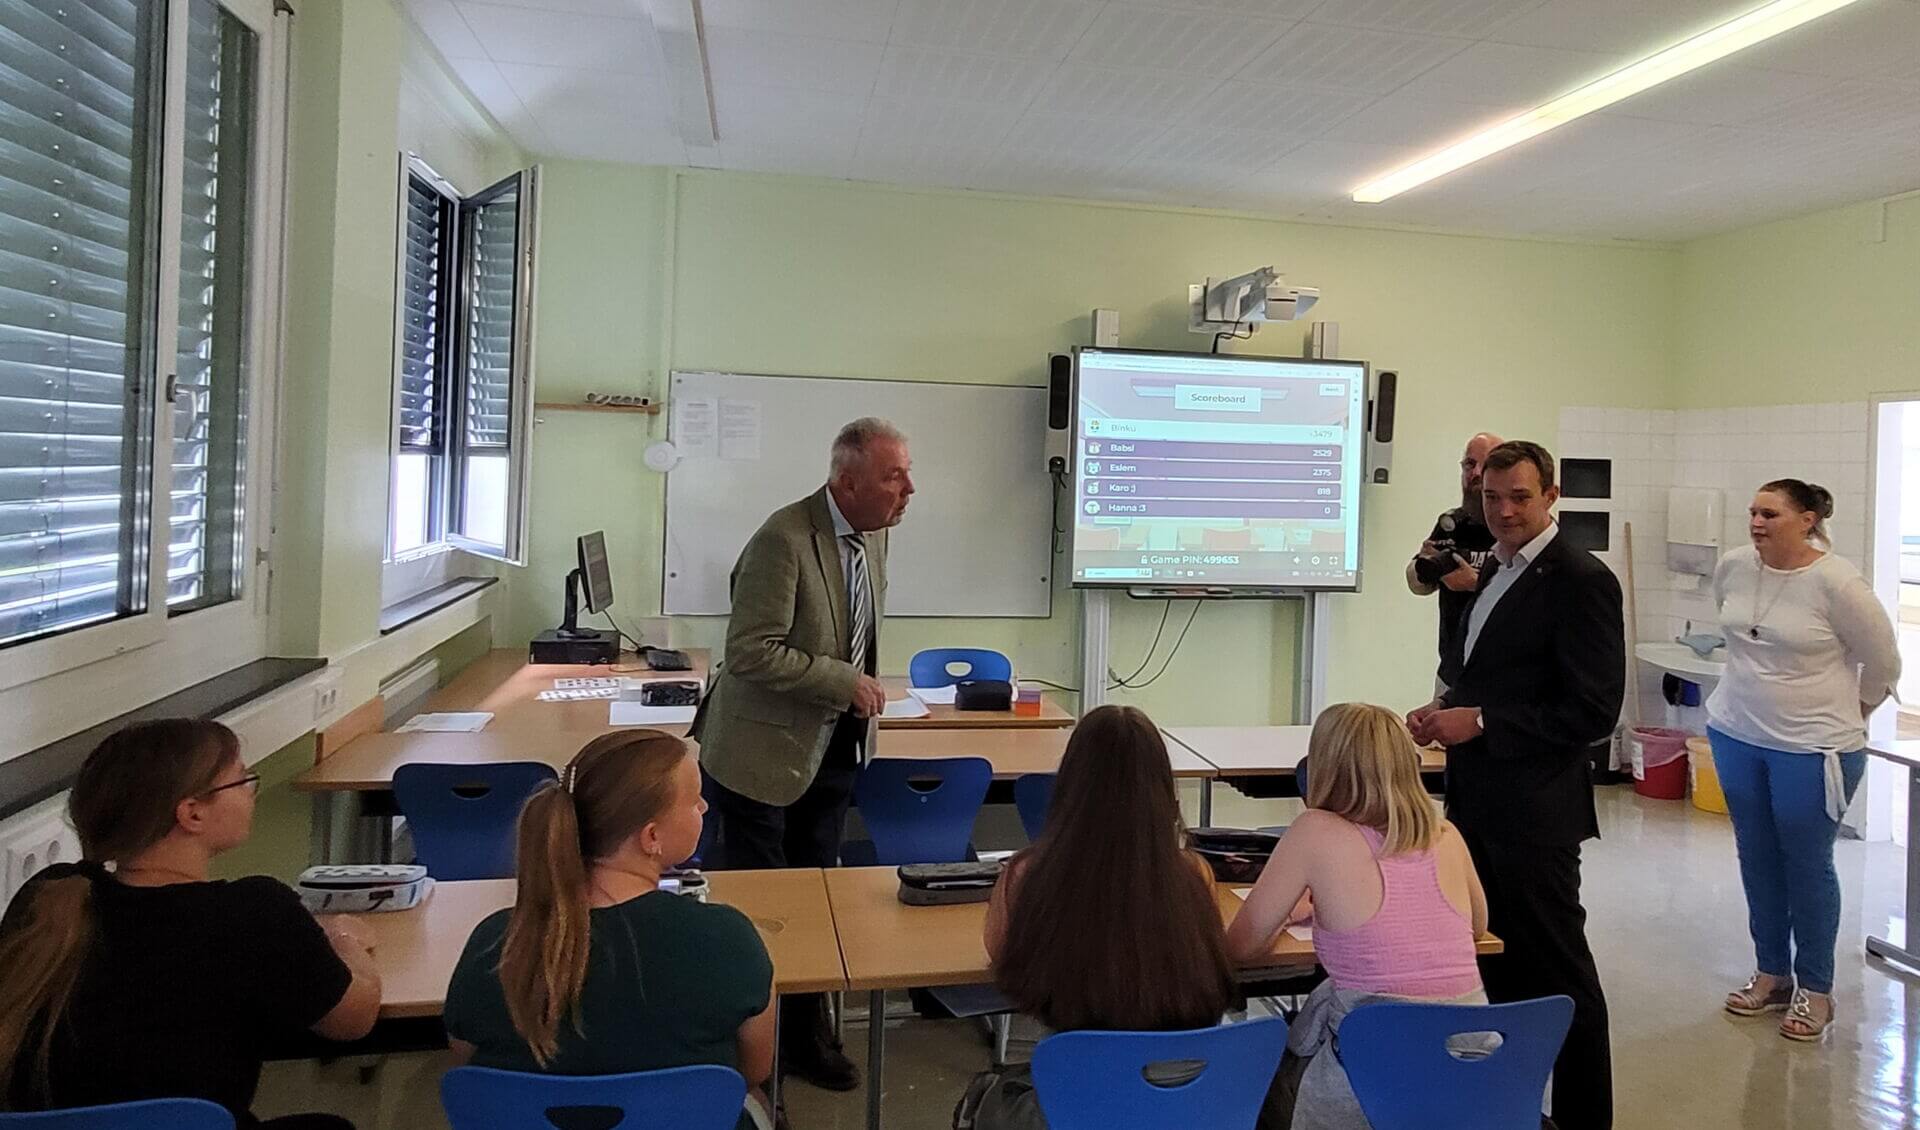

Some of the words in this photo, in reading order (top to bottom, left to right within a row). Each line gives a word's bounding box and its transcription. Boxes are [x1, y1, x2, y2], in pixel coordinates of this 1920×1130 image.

[1191, 392, 1246, 404] Scoreboard
[1109, 483, 1130, 492] Karo
[1108, 503, 1137, 512] Hanna
[1150, 555, 1180, 564] Game
[1182, 555, 1202, 564] PIN:
[1203, 555, 1239, 564] 499653
